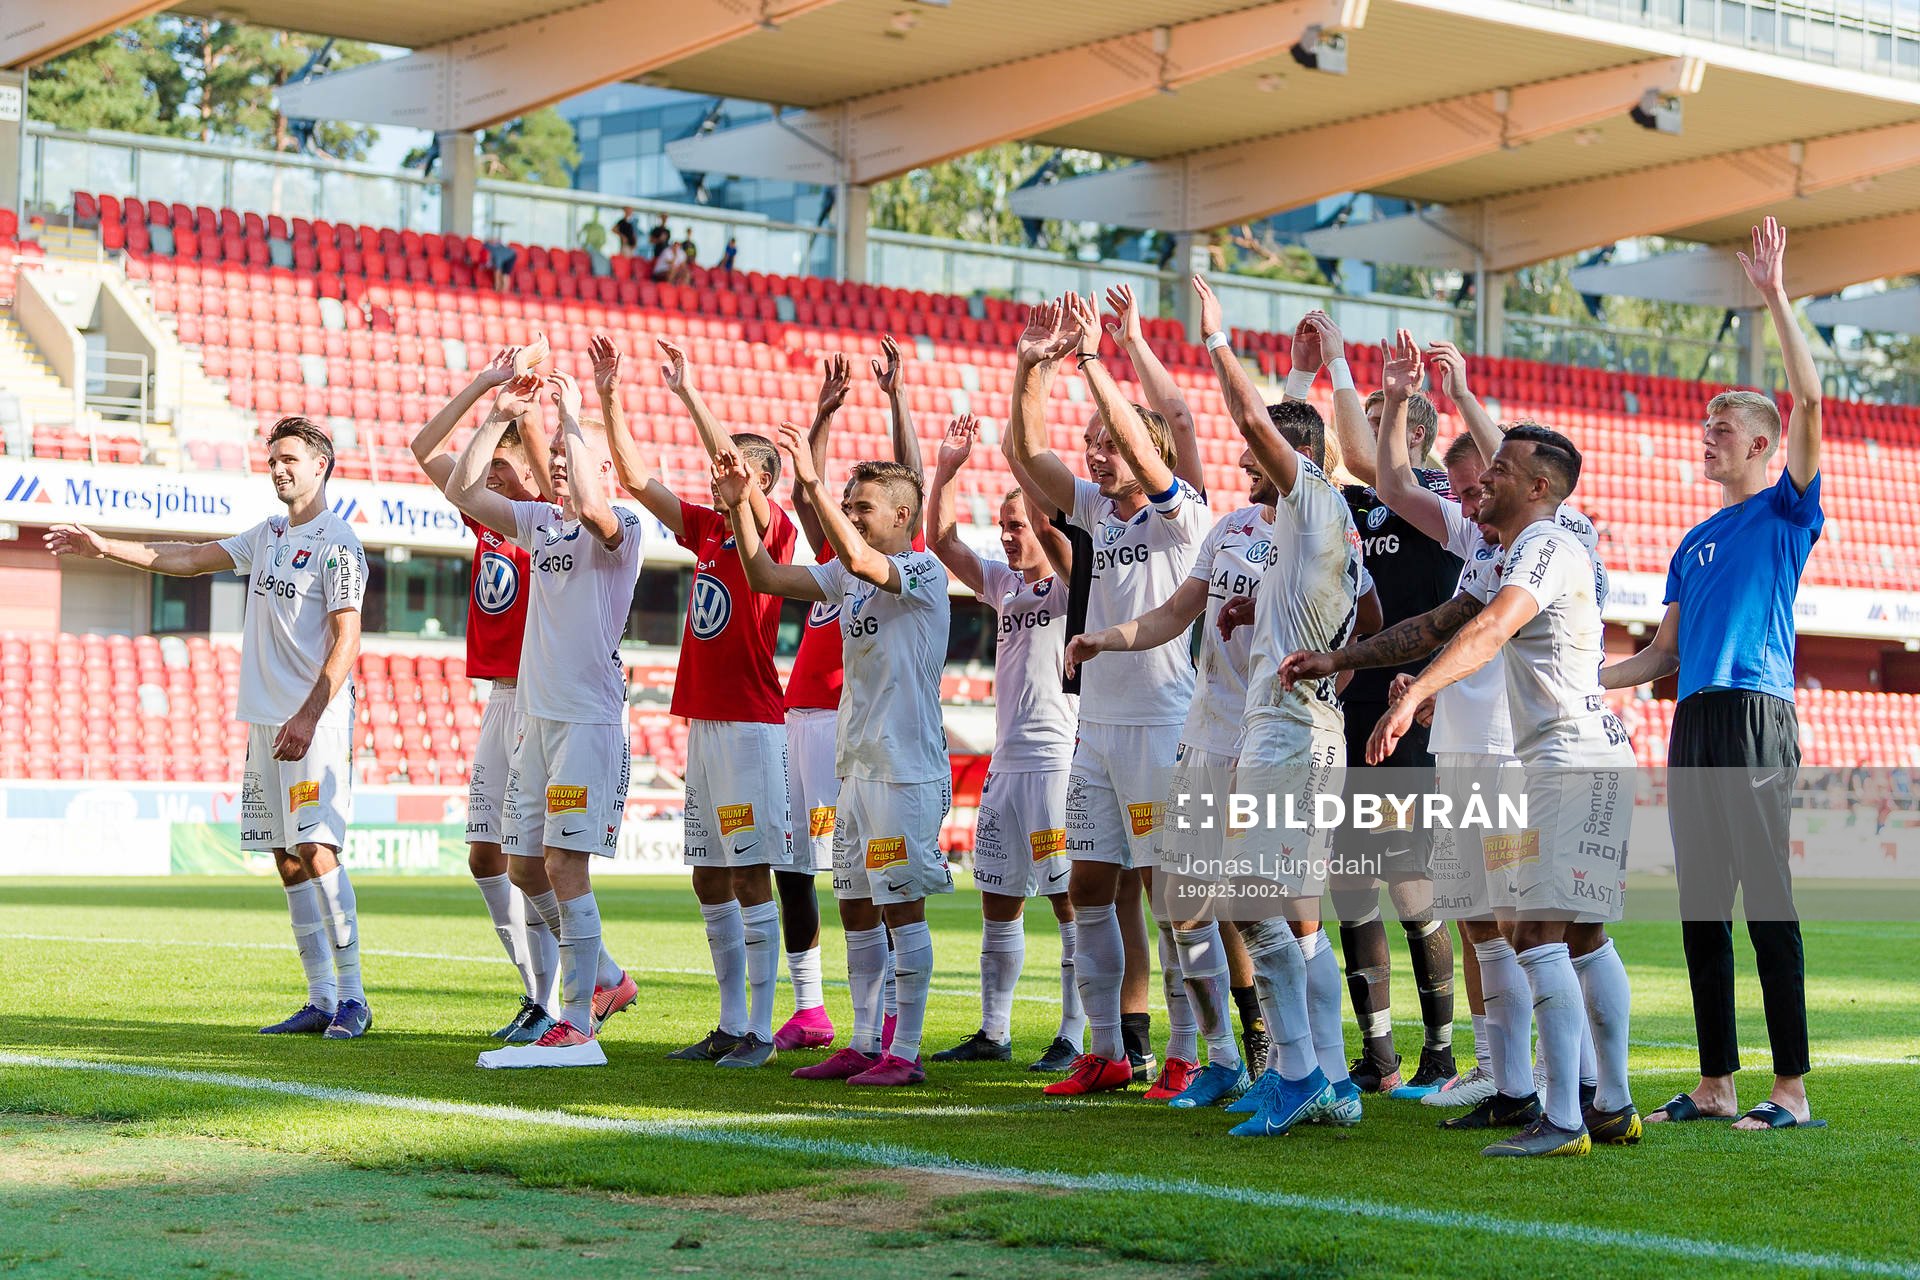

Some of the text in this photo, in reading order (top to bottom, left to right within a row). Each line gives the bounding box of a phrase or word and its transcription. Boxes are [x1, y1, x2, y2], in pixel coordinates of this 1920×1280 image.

[64, 477, 232, 518] Myresjöhus
[1362, 534, 1400, 556] YGG
[1697, 543, 1716, 567] 17
[1002, 609, 1051, 634] BYGG
[549, 789, 584, 798] TRIUMF
[551, 799, 576, 807] GLASS
[1137, 818, 1161, 827] GLASS
[1031, 833, 1063, 845] TRIUMF
